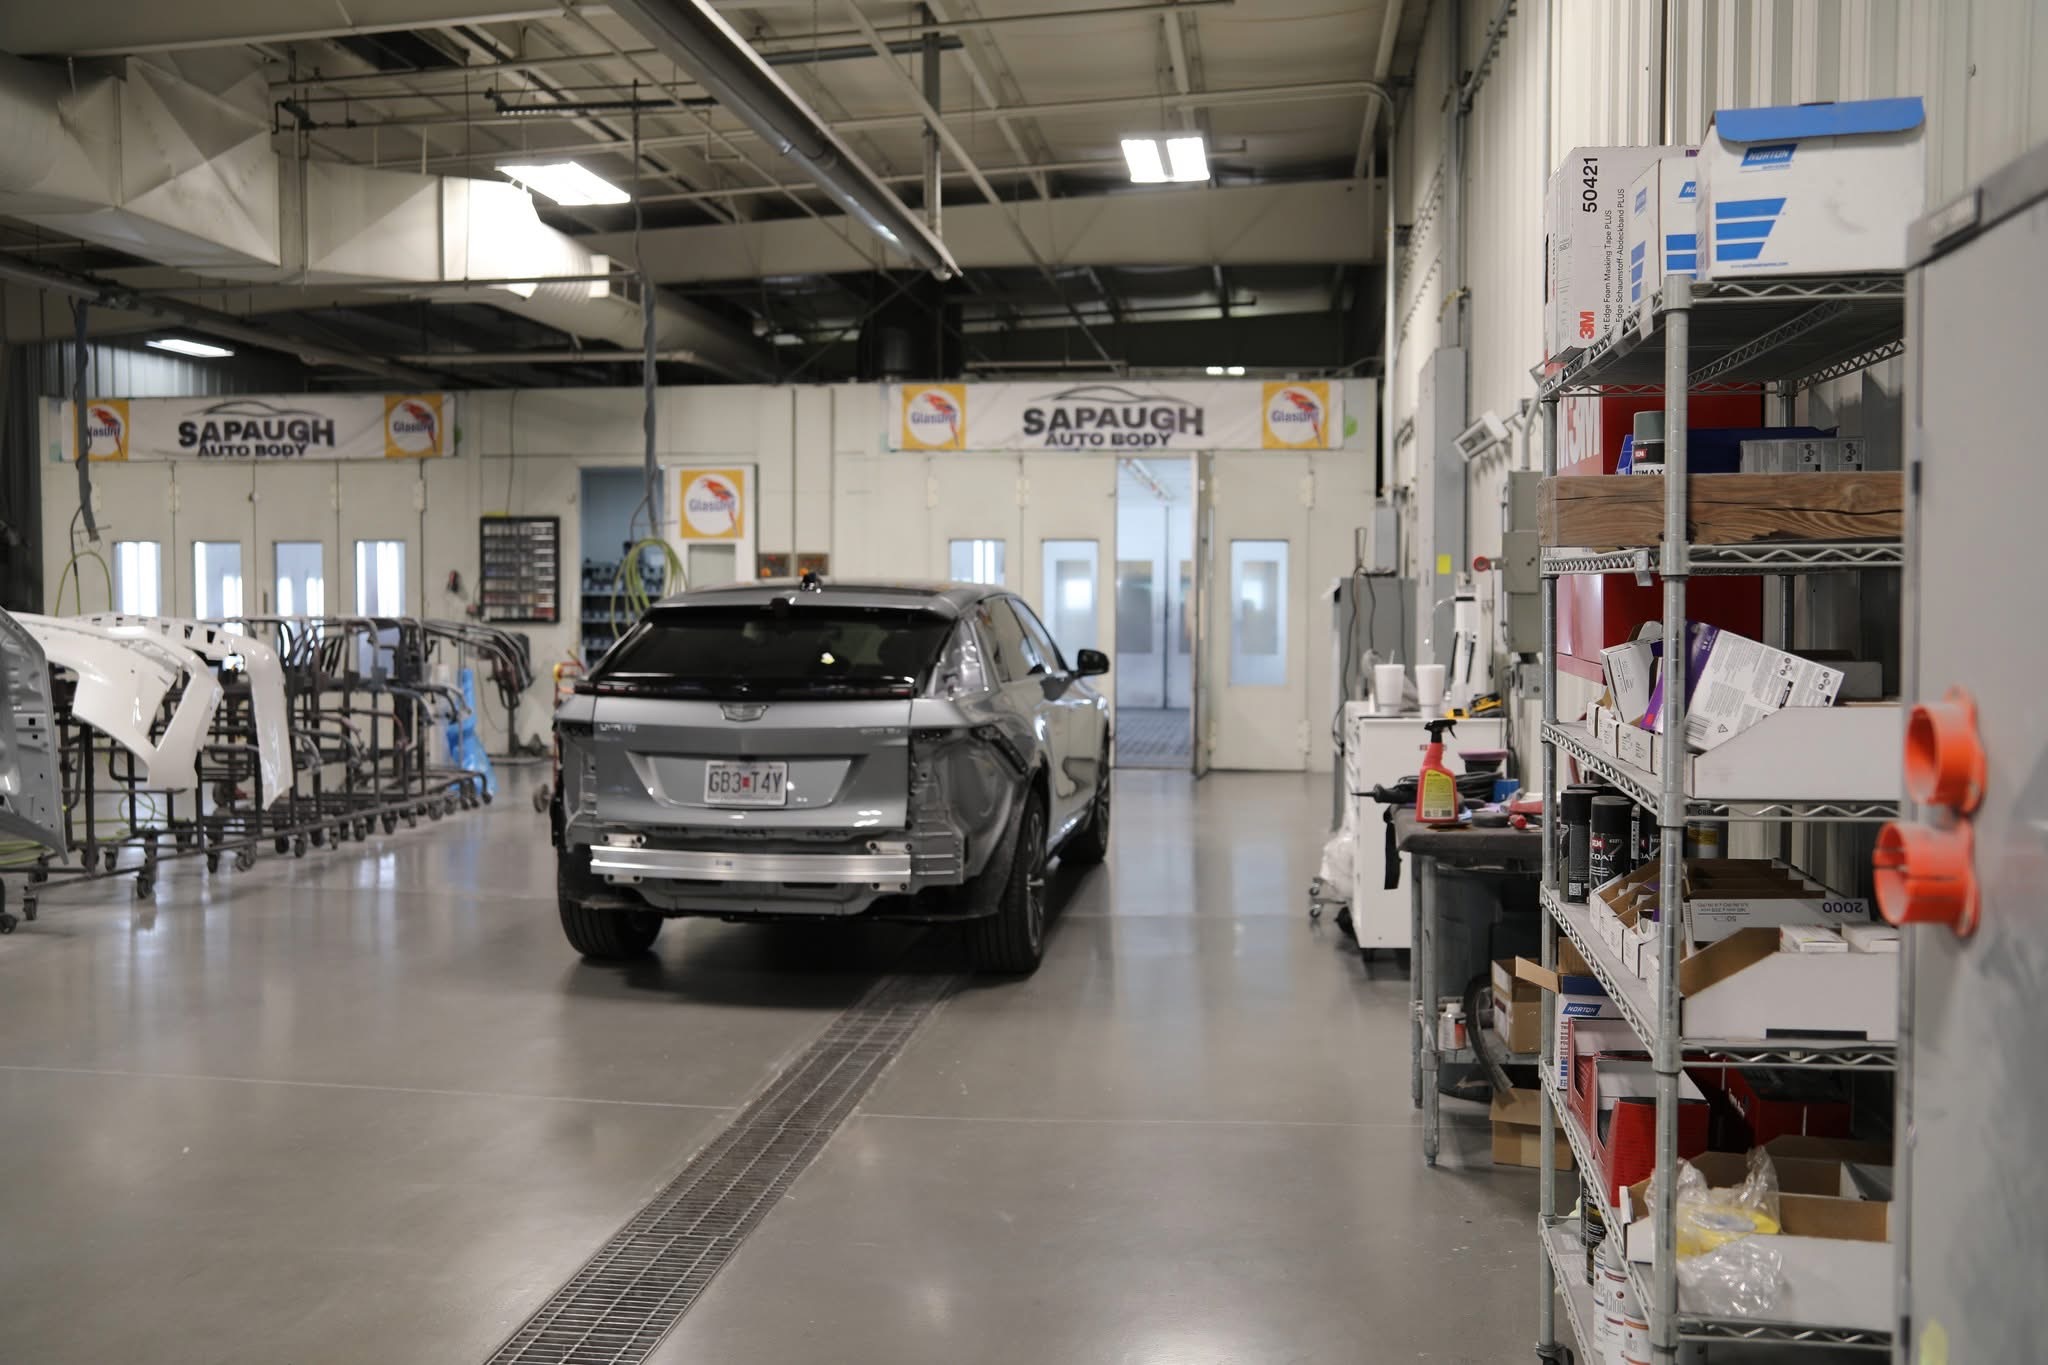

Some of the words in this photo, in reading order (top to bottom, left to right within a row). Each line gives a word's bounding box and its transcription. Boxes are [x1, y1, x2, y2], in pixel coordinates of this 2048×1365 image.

[1583, 157, 1598, 213] 50421
[1617, 188, 1625, 208] PLUS
[1604, 230, 1613, 249] Tape
[1604, 250, 1613, 281] Masking
[1616, 209, 1625, 301] Schaumstoff-Abdeckband
[1603, 302, 1613, 324] Edge
[1616, 302, 1625, 323] Edge
[1579, 311, 1595, 340] 3M
[1023, 406, 1203, 436] SAPAUGH
[178, 419, 335, 448] SAPAUGH
[1044, 433, 1104, 446] AUTO
[1111, 433, 1172, 446] BODY
[198, 444, 250, 457] AUTO
[254, 444, 307, 457] BODY
[709, 771, 742, 793] GB3
[751, 771, 783, 793] T4Y
[1822, 902, 1863, 914] 2000
[1568, 1005, 1597, 1013] NORTON
